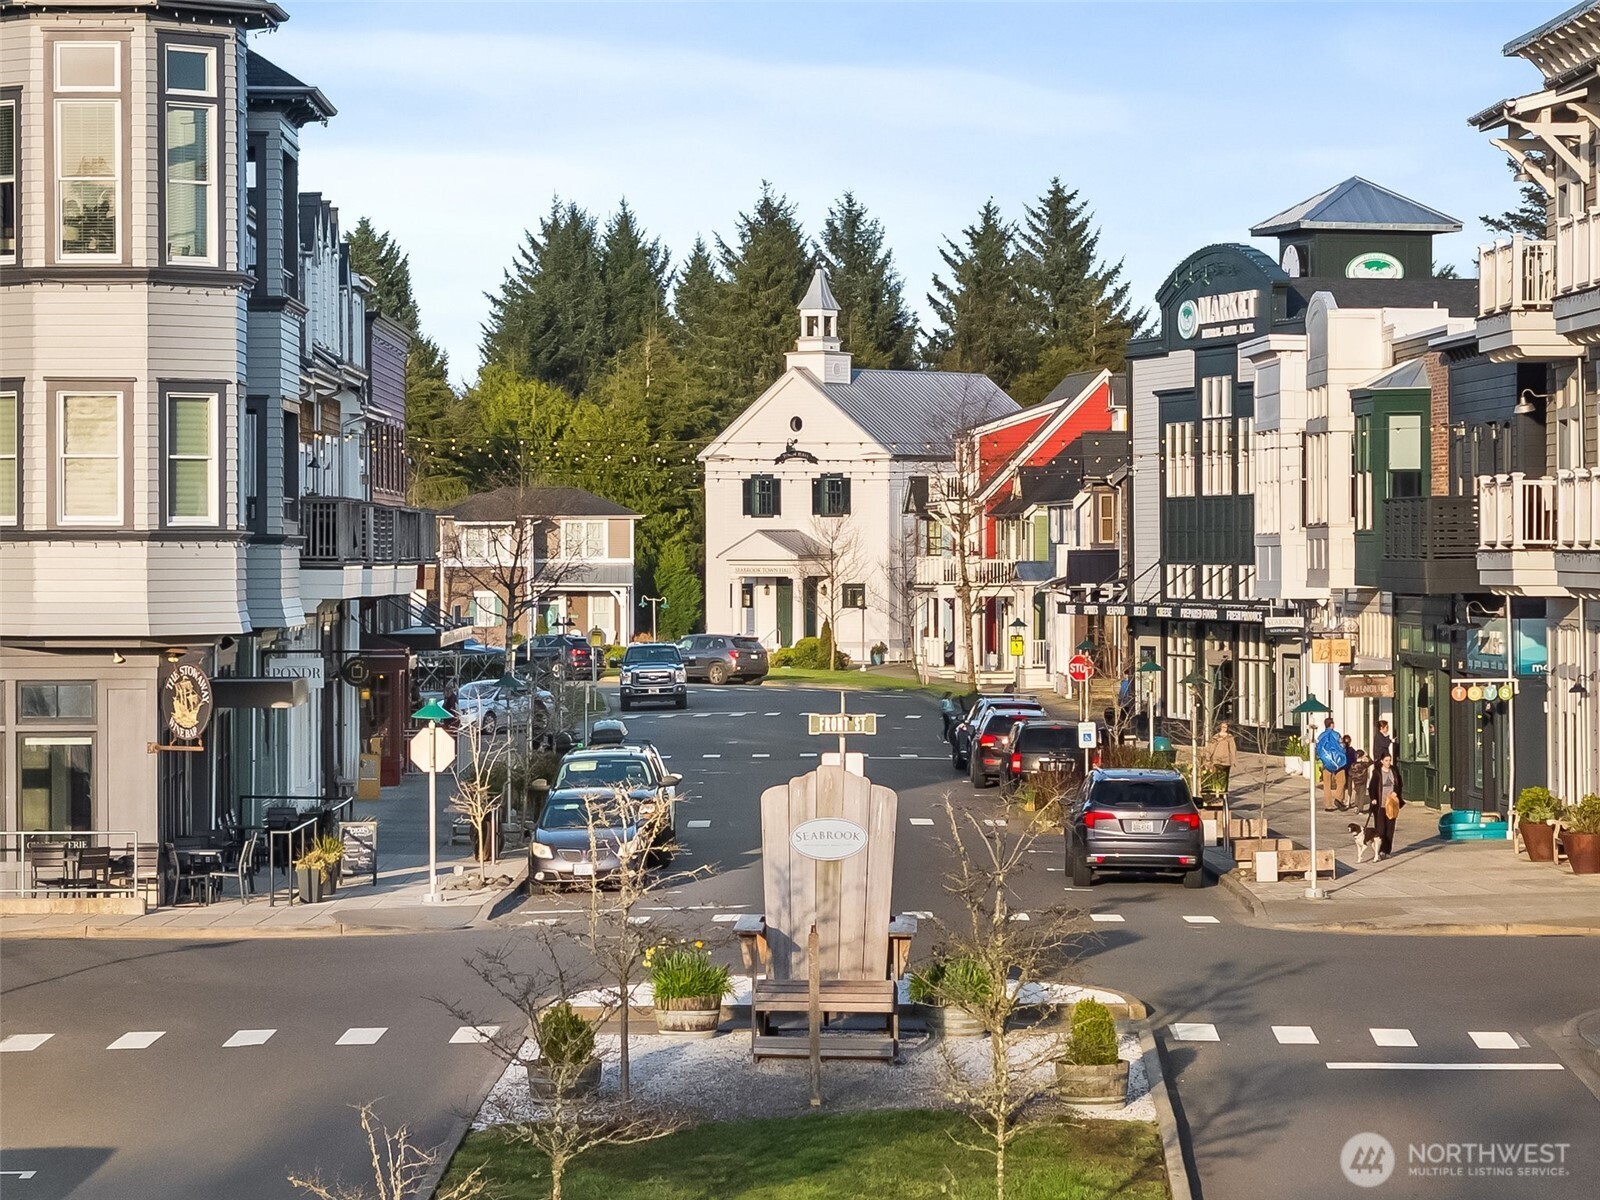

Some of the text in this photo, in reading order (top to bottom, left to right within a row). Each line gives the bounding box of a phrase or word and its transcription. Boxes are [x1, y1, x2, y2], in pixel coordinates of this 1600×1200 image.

[1197, 289, 1258, 325] MARKET
[1106, 605, 1126, 615] SEAFOOD
[1156, 607, 1172, 617] CHEESE
[1180, 608, 1218, 619] PREPARED FOODS
[1226, 610, 1263, 622] FRESH PRODUCE
[272, 667, 321, 679] PONDR
[1069, 662, 1091, 673] STO
[165, 665, 210, 704] THE STOWAWAY
[1454, 688, 1510, 699] TOYS
[169, 717, 198, 738] WINE BAR
[819, 716, 867, 732] FRONT ST
[795, 830, 860, 842] SEABROOK
